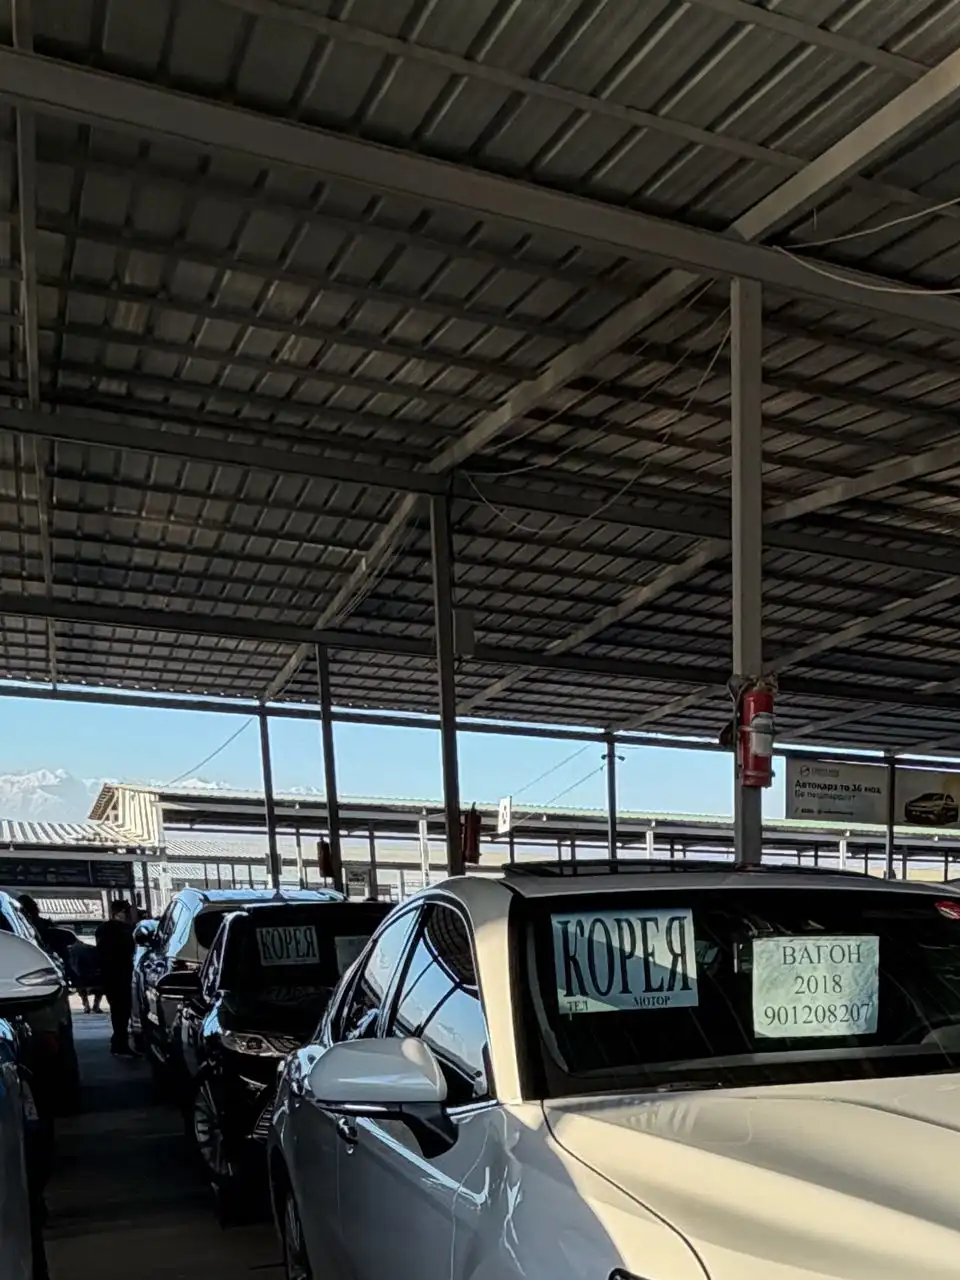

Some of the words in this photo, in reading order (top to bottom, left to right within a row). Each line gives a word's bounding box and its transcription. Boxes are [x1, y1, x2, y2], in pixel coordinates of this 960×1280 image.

[260, 927, 316, 960] КОРЕЯ
[783, 944, 862, 966] ВАГОН
[557, 915, 693, 998] КОРЕЯ
[794, 975, 843, 995] 2018
[763, 1003, 872, 1027] 901208207
